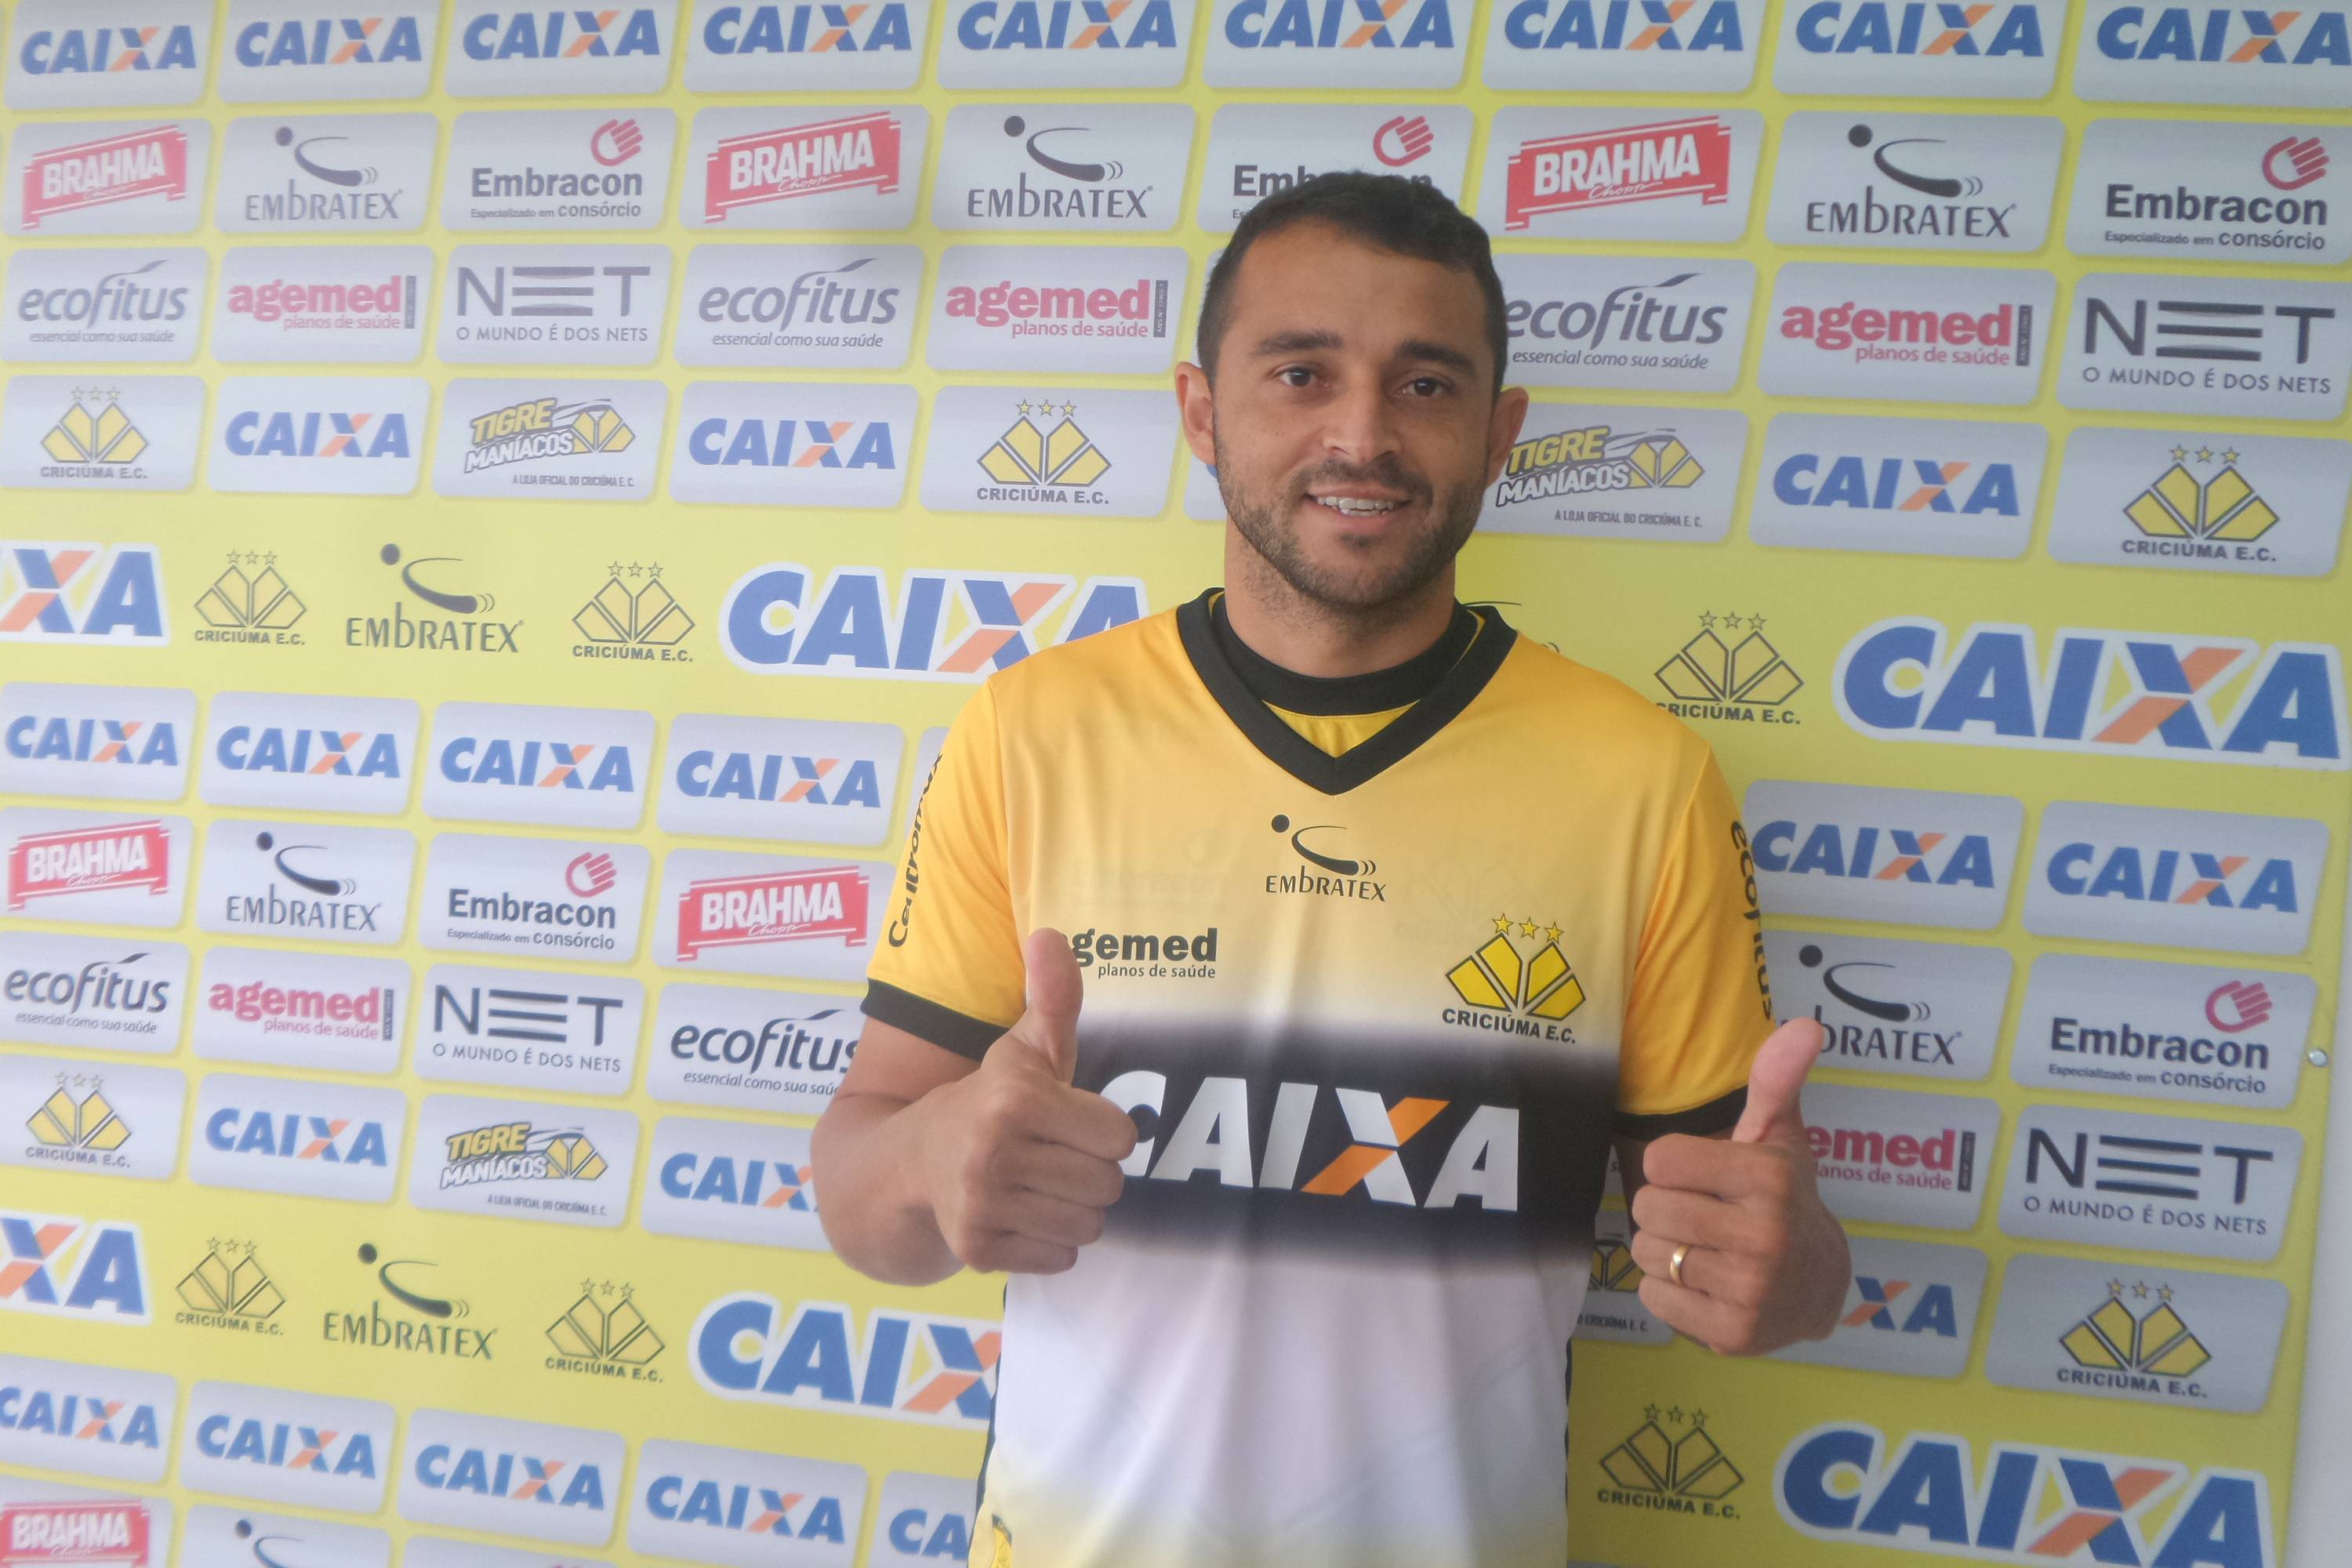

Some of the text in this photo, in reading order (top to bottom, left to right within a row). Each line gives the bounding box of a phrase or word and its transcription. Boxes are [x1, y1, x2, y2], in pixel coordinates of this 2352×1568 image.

[235, 16, 422, 67] CAIXA
[463, 9, 660, 60] CAIXA
[703, 3, 912, 54] CAIXA
[957, 0, 1177, 50] CAIXA
[1225, 0, 1454, 48] CAIXA
[1505, 0, 1744, 51] CAIXA
[1795, 1, 2044, 57] CAIXA
[2097, 6, 2351, 65] CAIXA
[20, 24, 197, 74] CAIXA
[43, 142, 165, 200] BRAHMA
[471, 168, 642, 198] Embracon
[730, 130, 874, 191] BRAHMA
[1534, 134, 1700, 196] BRAHMA
[557, 201, 641, 217] consórcio
[2106, 185, 2327, 225] Embracon
[2219, 230, 2325, 251] consórcio
[19, 261, 188, 328] ecofitus
[228, 275, 401, 321] agemed
[456, 267, 650, 317] NET
[699, 259, 900, 332] ecofitus
[946, 280, 1150, 327] agemed
[456, 323, 648, 341] O MUNDO É DOS NETS
[713, 332, 884, 347] essencial como sua saúde
[1012, 319, 1149, 339] planos de saúde
[1781, 301, 2013, 350] agemed
[2085, 298, 2335, 365] NET
[1512, 350, 1708, 369] essencial como sua saúde
[1856, 341, 2010, 365] planos de saúde
[2082, 367, 2331, 394] O MUNDO É DOS NETS
[224, 412, 410, 458] CAIXA
[472, 397, 557, 443] TIGRE
[464, 431, 574, 473] MANÍACOS
[689, 418, 896, 470] CAIXA
[1507, 426, 1610, 475] TIGRE
[977, 487, 1067, 503] CRICIÚMA
[1496, 463, 1629, 506] MANÍACOS
[1773, 454, 2020, 516] CAIXA
[1639, 513, 1681, 526] CRICIÚMA
[2122, 540, 2227, 559] CRICIÚMA
[194, 629, 270, 644] CRICIÚMA
[572, 644, 655, 660] CRICIÚMA
[1656, 702, 1754, 721] RICIÚMA
[1844, 626, 2340, 759] CAIXA
[5, 715, 179, 767] CAIXA
[216, 726, 401, 779] CAIXA
[440, 737, 634, 793] CAIXA
[676, 750, 881, 808] CAIXA
[27, 835, 149, 883] BRAHMA
[1751, 820, 1994, 888] CAIXA
[2047, 842, 2298, 913] CAIXA
[448, 887, 615, 929] Embracon
[702, 881, 843, 931] BRAHMA
[534, 931, 615, 949] consórcio
[1071, 927, 1218, 967] gemed
[3, 953, 169, 1014] ecofitus
[1098, 963, 1215, 978] planos de saúde
[208, 980, 379, 1024] agemed
[434, 985, 623, 1047] NET
[1442, 1008, 1540, 1037] CRICIÚMA
[264, 1017, 379, 1040] planos de saúde
[2050, 1018, 2269, 1069] Embracon
[433, 1043, 620, 1073] O MUNDO É DOS NETS
[684, 1071, 807, 1093] essencial como sua
[2161, 1070, 2266, 1094] consórcio
[205, 1108, 387, 1167] CAIXA
[446, 1122, 530, 1163] TIGRE
[440, 1153, 548, 1189] MANÍACOS
[2026, 1128, 2273, 1204] NET
[2024, 1196, 2267, 1236] O MUNDO É DOS NETS
[176, 1312, 250, 1332] CRICIÚMA
[546, 1357, 626, 1378] CRICIÚMA
[2056, 1369, 2160, 1393] CRICIÚMA
[196, 1414, 376, 1479] CAIXA
[414, 1443, 604, 1512] CAIXA
[1784, 1430, 2263, 1568] CAIXA
[645, 1475, 845, 1545] CAIXA
[1597, 1490, 1695, 1514] CRICIÚMA
[13, 1512, 130, 1549] BRAHMA
